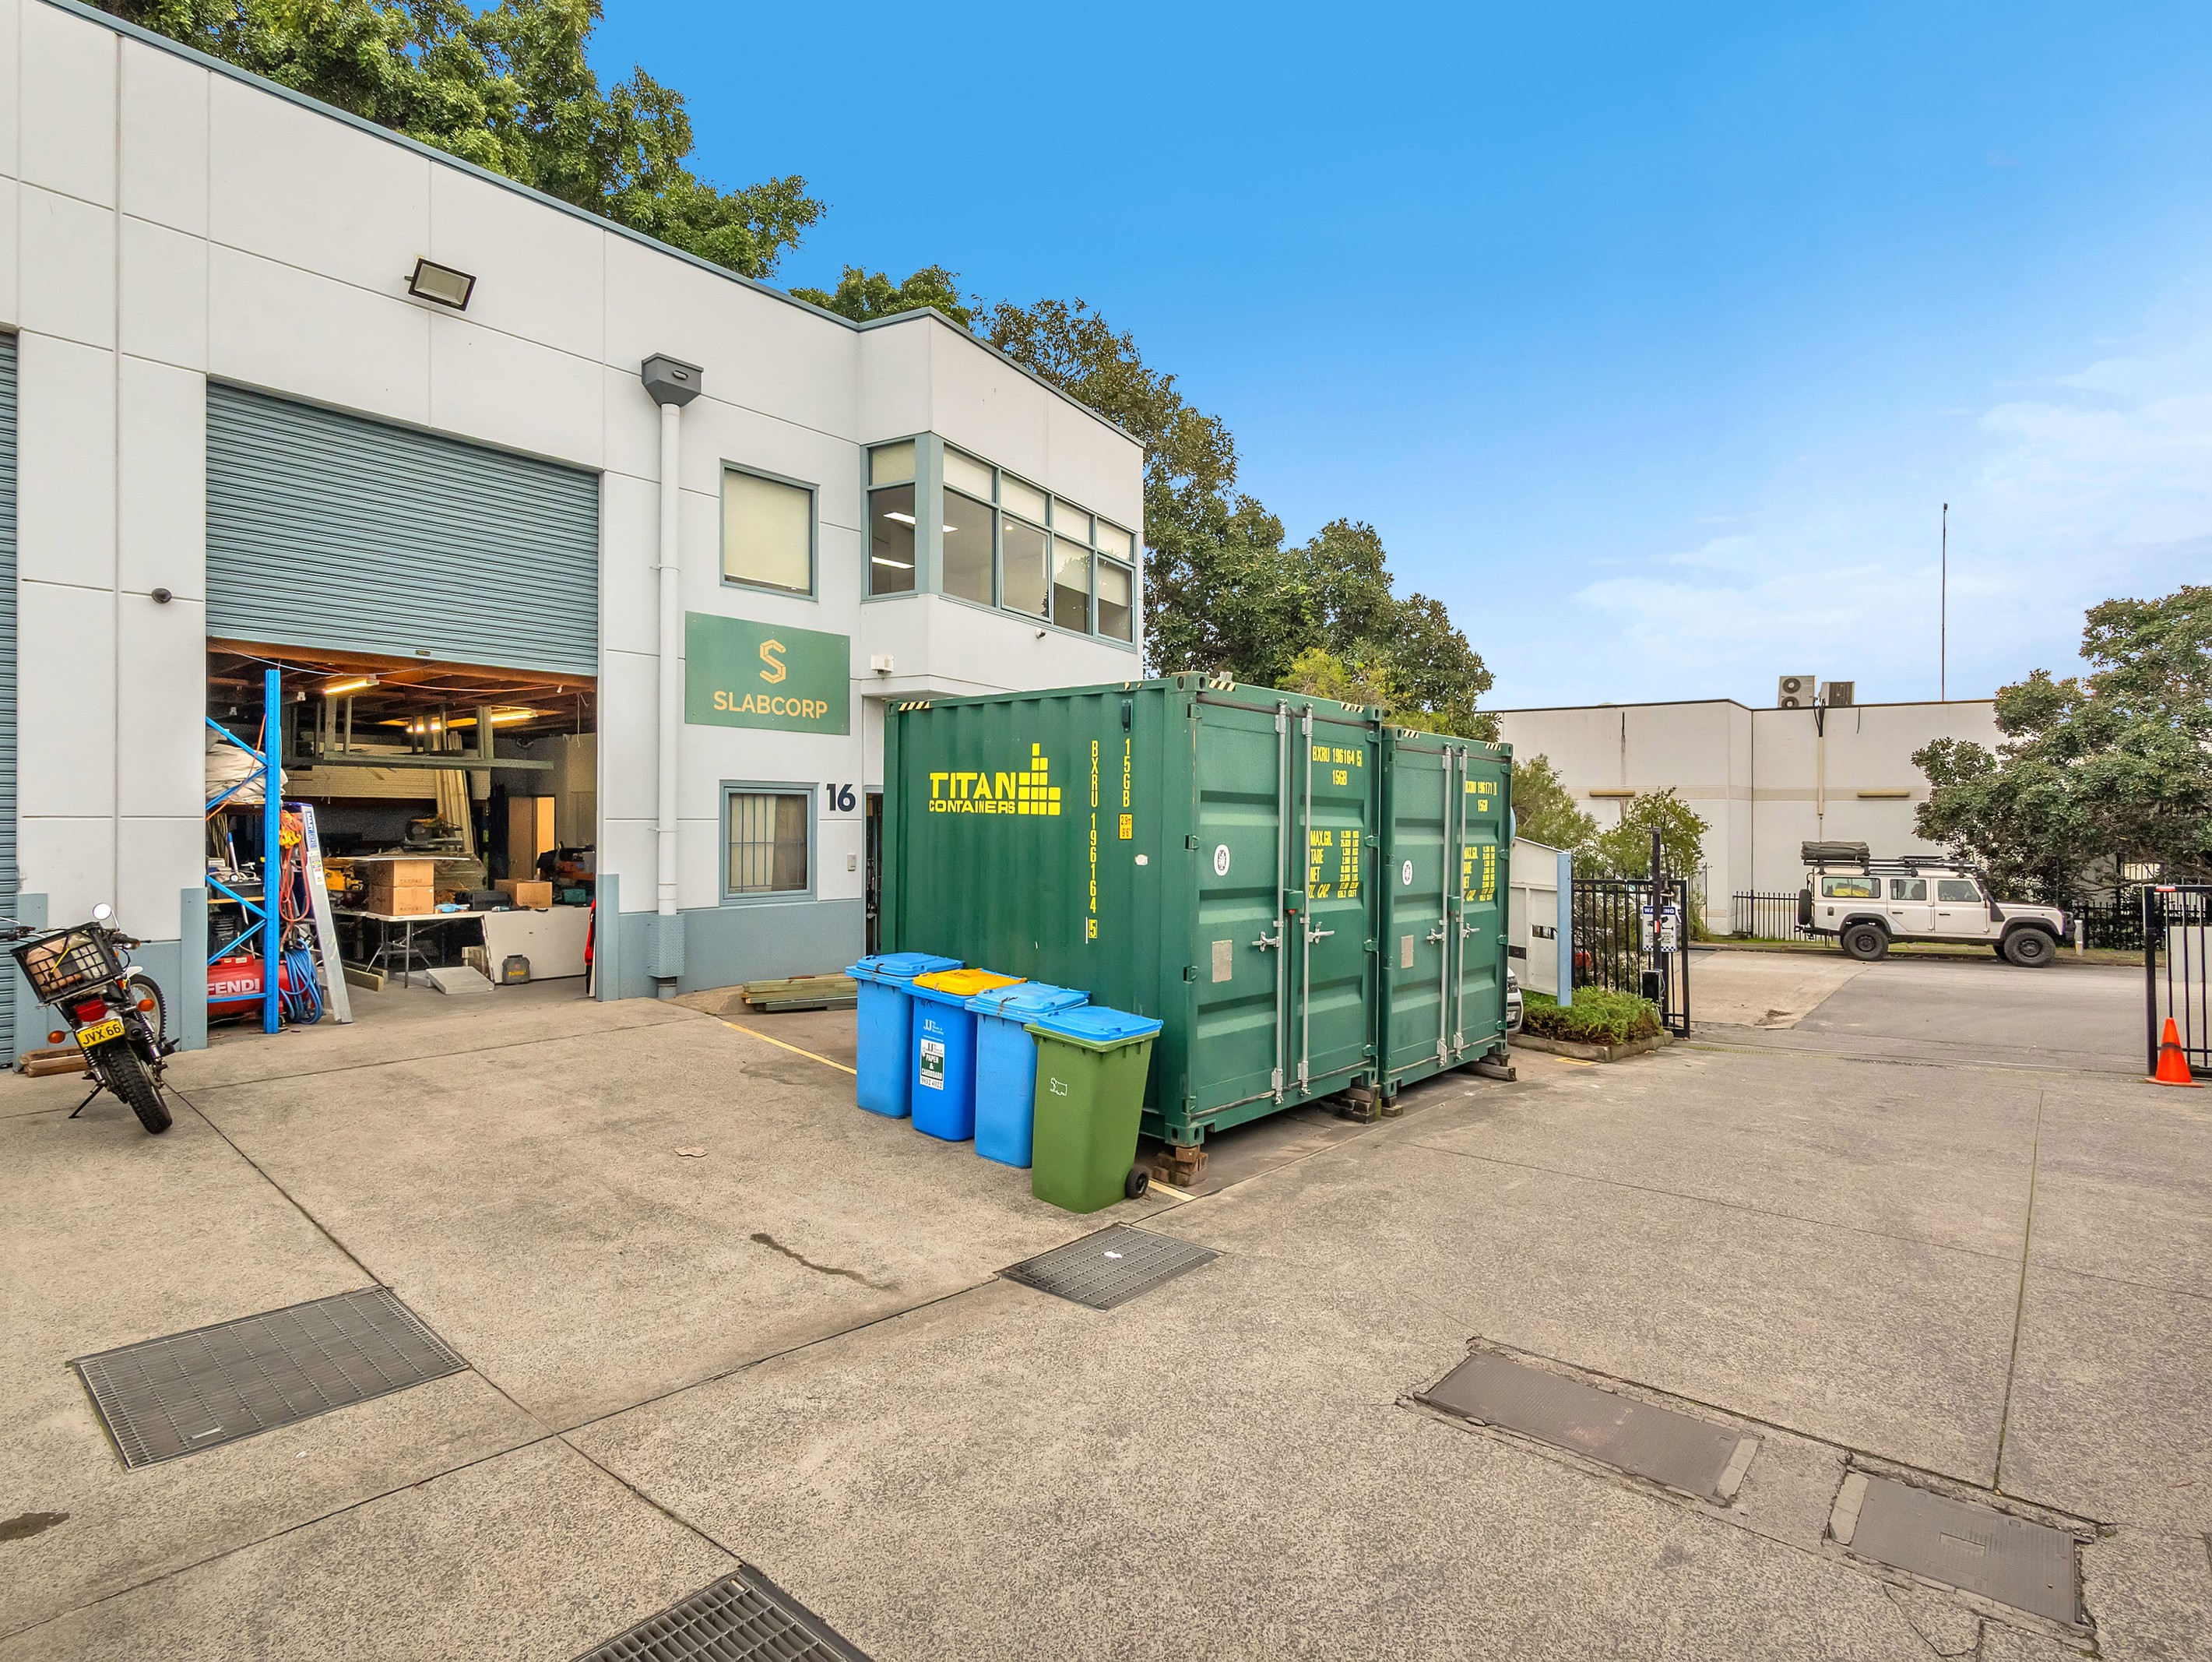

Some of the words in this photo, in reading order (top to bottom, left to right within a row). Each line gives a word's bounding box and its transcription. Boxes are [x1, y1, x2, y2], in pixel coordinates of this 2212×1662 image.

[760, 639, 786, 684] S
[713, 691, 828, 719] SLABCORP
[1312, 745, 1330, 762] BXRU
[1332, 748, 1355, 766] 196164
[930, 772, 1016, 799] TITAN
[1332, 769, 1348, 786] 15GB
[826, 783, 856, 812] 16
[929, 801, 1015, 814] CONTAINERS
[1310, 848, 1324, 864] TARE
[1310, 866, 1321, 882] NET
[1089, 920, 1097, 938] 5
[83, 1029, 105, 1044] JVX
[106, 1024, 121, 1036] 66
[926, 1054, 939, 1064] PAPER
